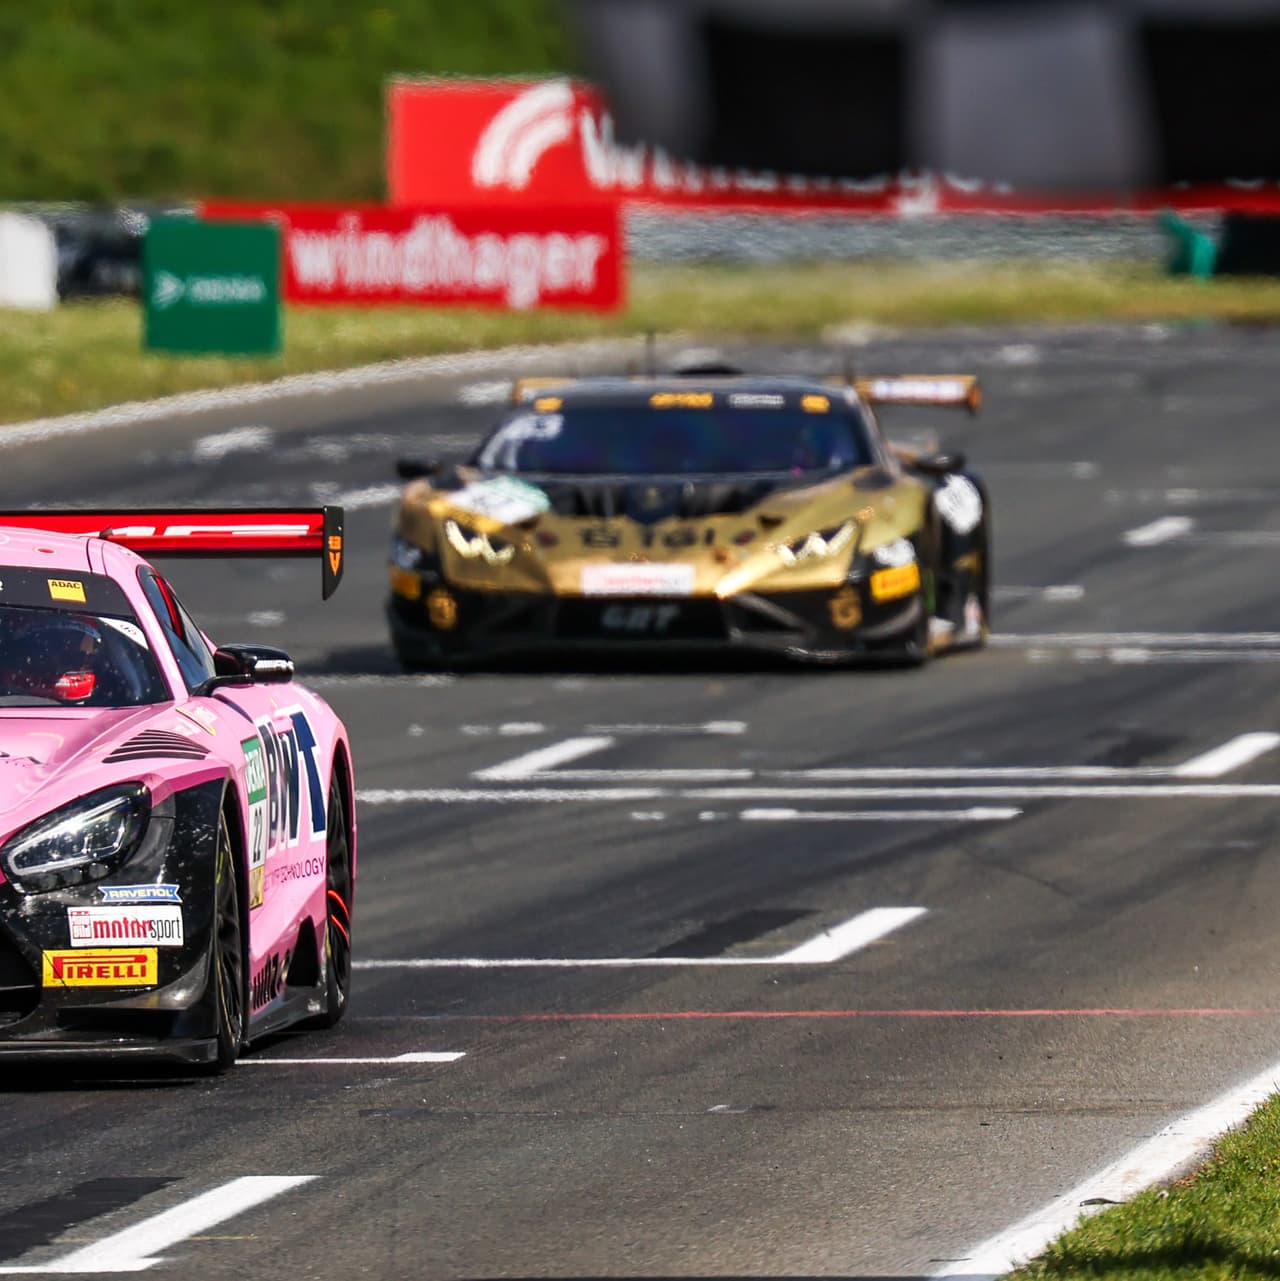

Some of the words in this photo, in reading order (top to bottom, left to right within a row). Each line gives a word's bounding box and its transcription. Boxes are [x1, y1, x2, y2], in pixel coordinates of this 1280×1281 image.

[288, 214, 608, 308] windhager
[50, 580, 81, 590] ADAC
[256, 707, 328, 854] BWT
[109, 888, 175, 898] RAVENOL
[93, 917, 182, 941] motorsport
[52, 954, 148, 979] PIRELLI
